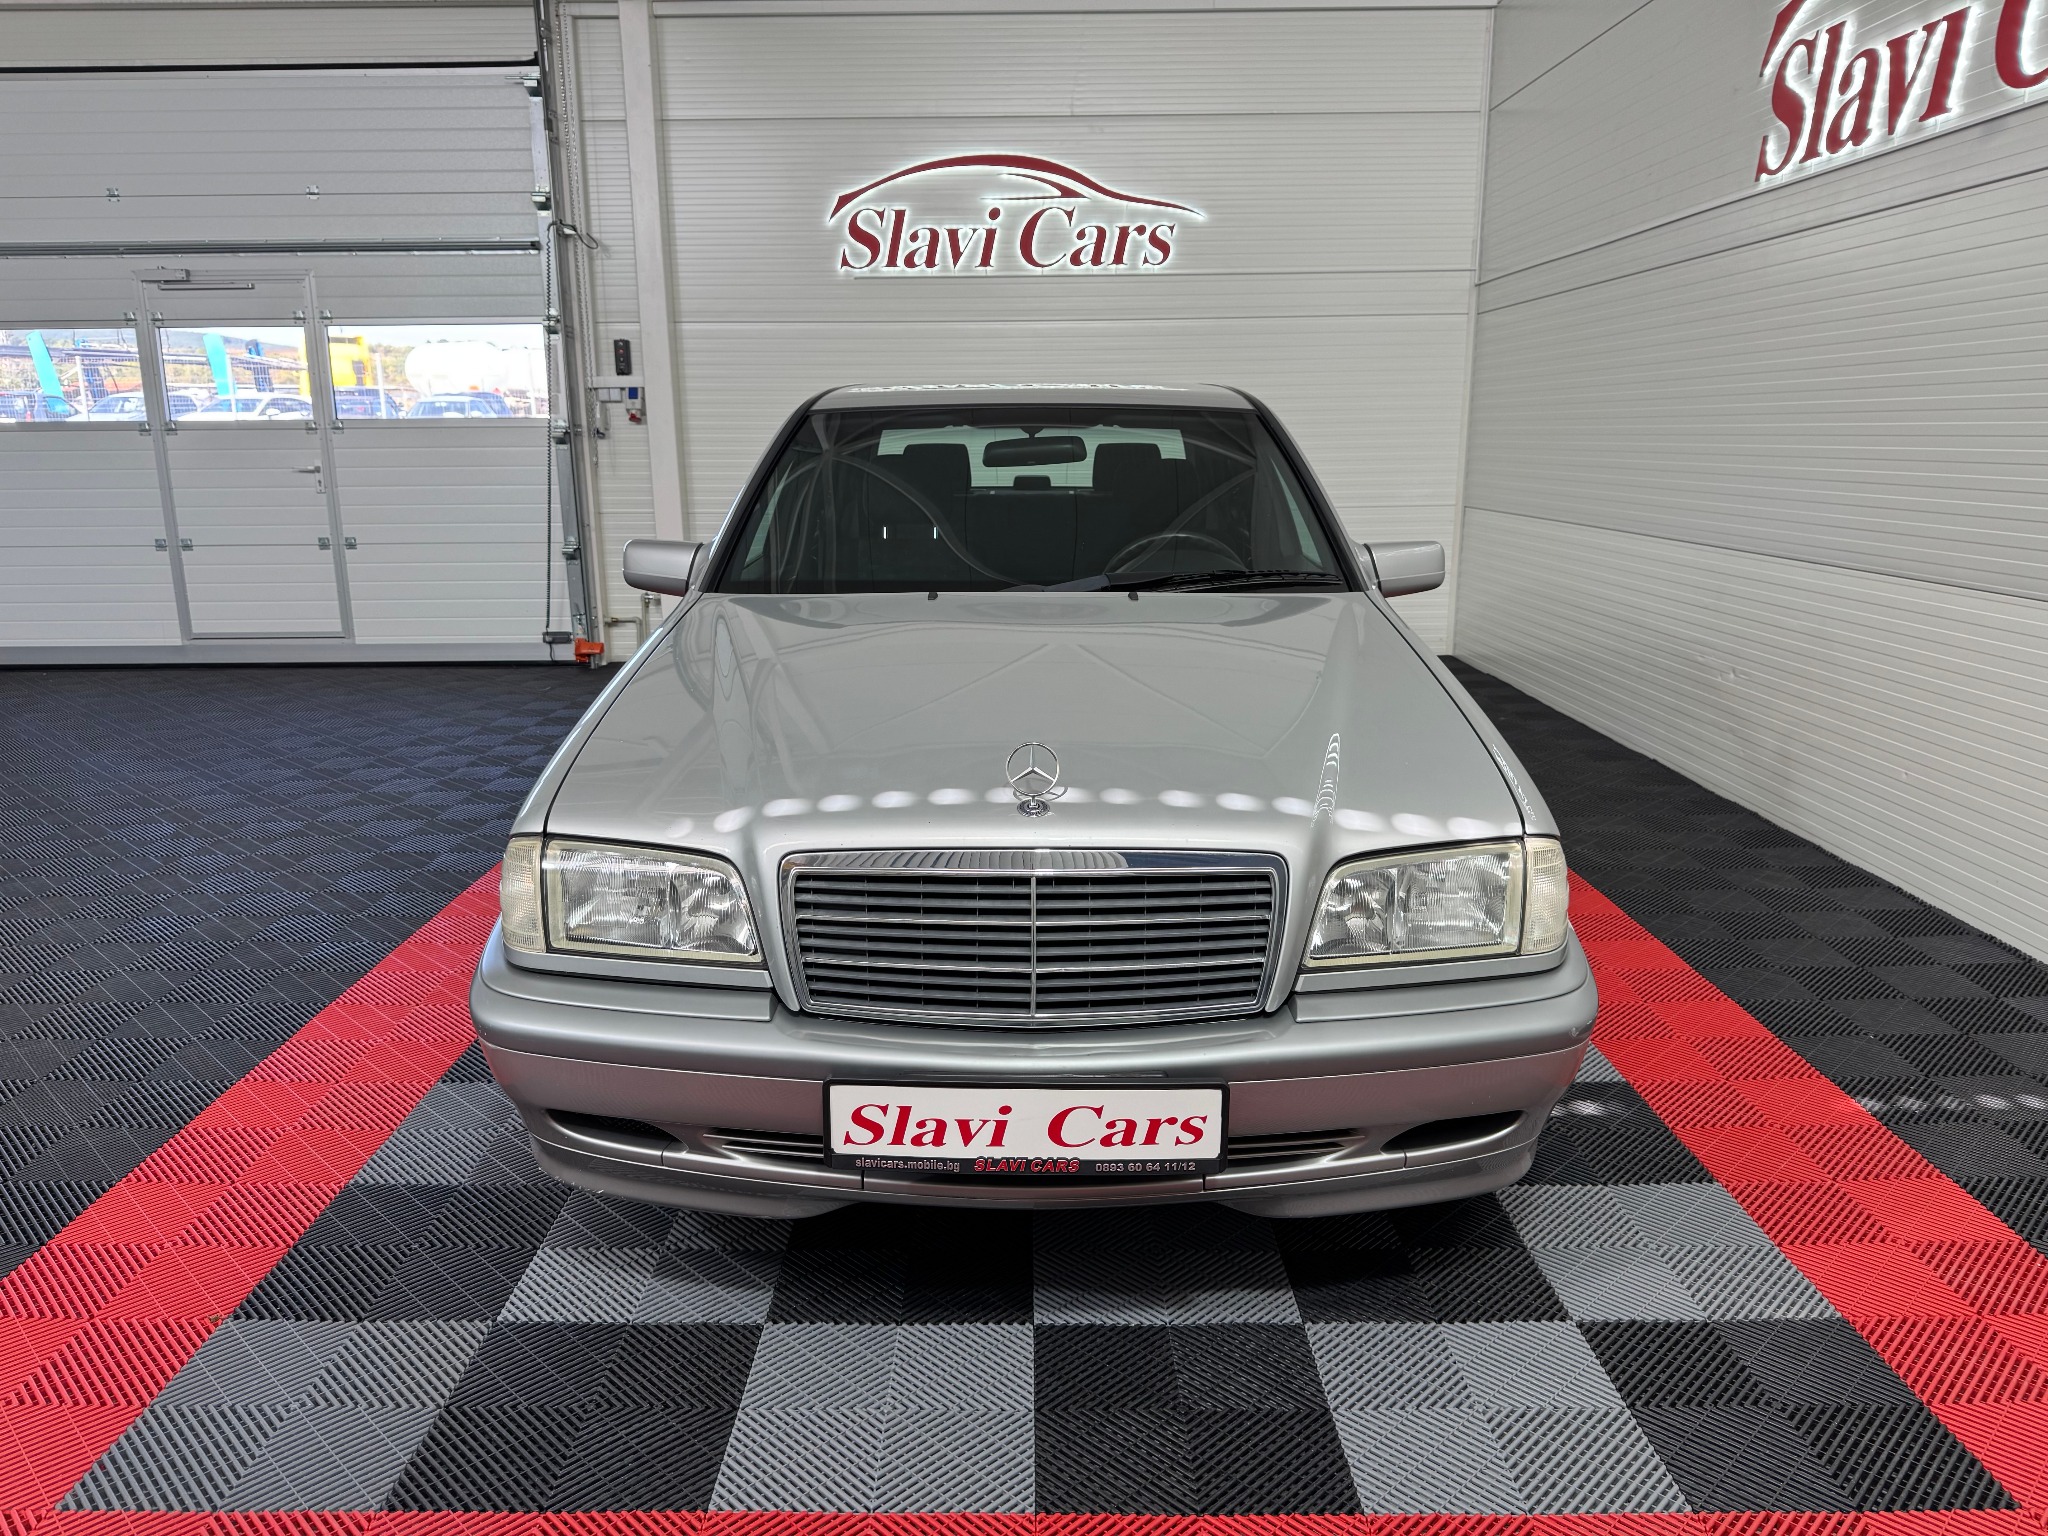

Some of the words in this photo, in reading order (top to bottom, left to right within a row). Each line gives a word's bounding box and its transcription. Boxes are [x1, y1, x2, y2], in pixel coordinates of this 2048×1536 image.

[1755, 6, 1973, 182] Slavi
[840, 206, 1002, 270] Slavi
[1019, 206, 1176, 268] Cars
[843, 1104, 1013, 1148] Slavi
[1047, 1104, 1209, 1148] Cars
[855, 1157, 960, 1173] slavicars.mobile.bg
[974, 1158, 1027, 1172] SLAVI
[1030, 1158, 1080, 1173] CARS
[1095, 1163, 1124, 1172] 0893
[1127, 1162, 1142, 1172] 60
[1145, 1162, 1161, 1172] 64
[1164, 1161, 1196, 1171] 11/12
